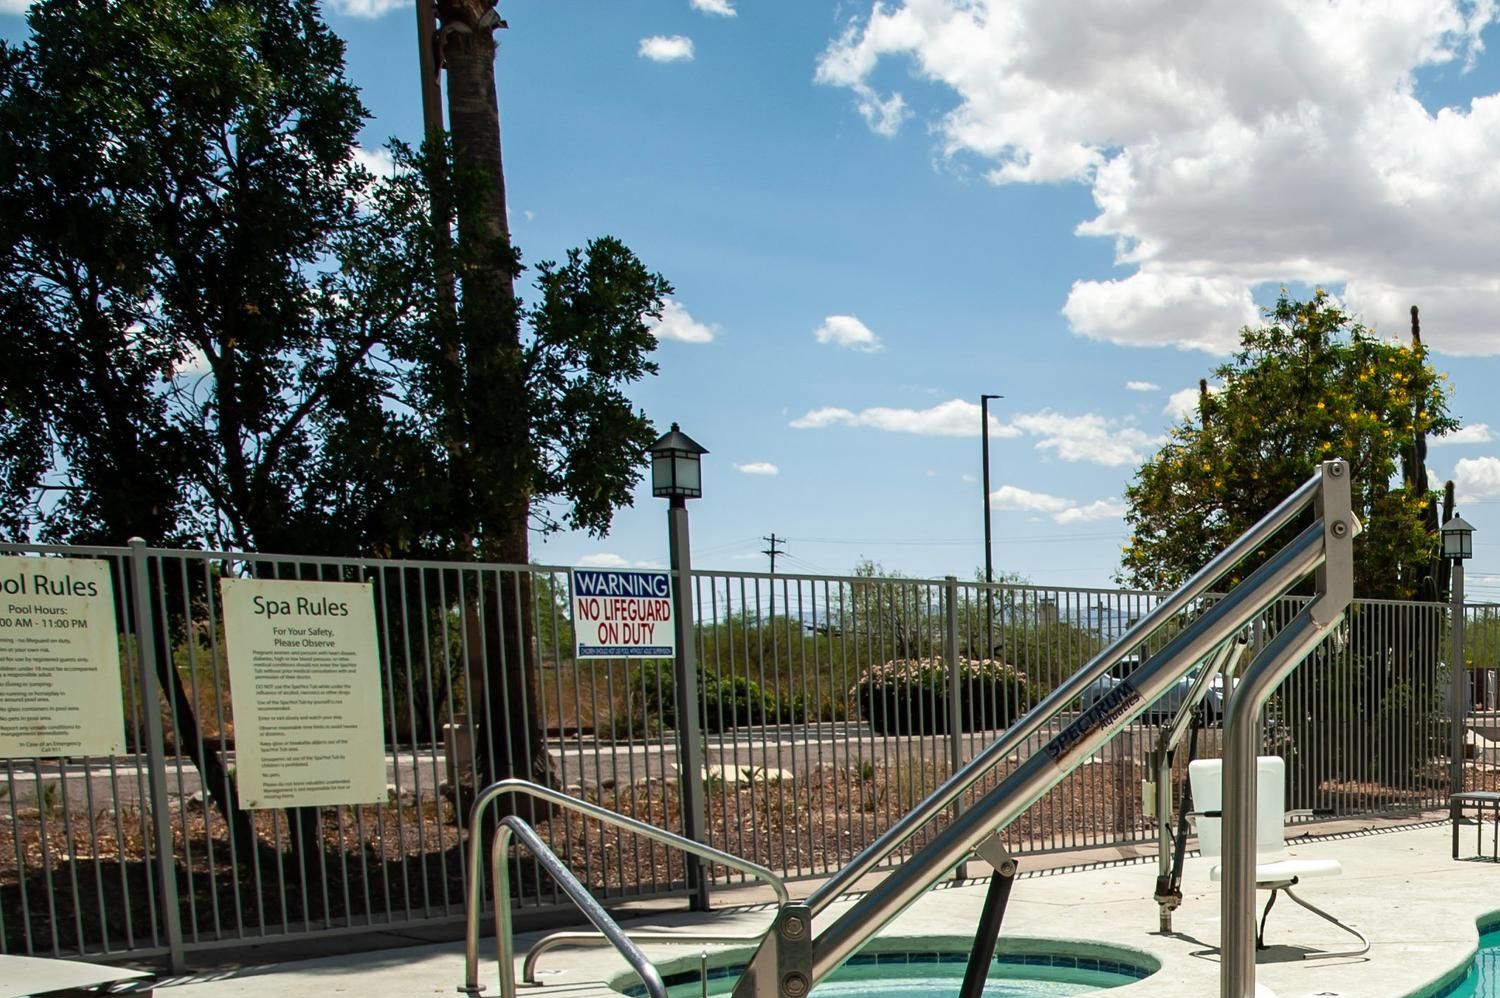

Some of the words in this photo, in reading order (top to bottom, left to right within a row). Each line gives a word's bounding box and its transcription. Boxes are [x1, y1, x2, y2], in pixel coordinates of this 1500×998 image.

[0, 573, 26, 594] ol
[34, 575, 98, 596] Rules
[577, 573, 667, 596] WARNING
[8, 605, 32, 614] Pool
[34, 606, 68, 614] Hours:
[254, 596, 290, 619] Spa
[297, 596, 348, 616] Rules
[579, 598, 600, 620] NO
[604, 599, 670, 621] LIFEGUARD
[0, 618, 12, 627] 00
[15, 618, 32, 627] AM
[42, 619, 69, 628] 11:00
[72, 620, 88, 628] PM
[273, 627, 286, 635] For
[288, 627, 306, 636] Your
[308, 628, 335, 637] Safety,
[598, 623, 618, 645] ON
[623, 623, 654, 645] DUTY
[274, 639, 300, 647] Please
[302, 639, 335, 647] Observe
[1048, 681, 1134, 757] SPECTRUM
[1100, 694, 1140, 731] Aquatics
